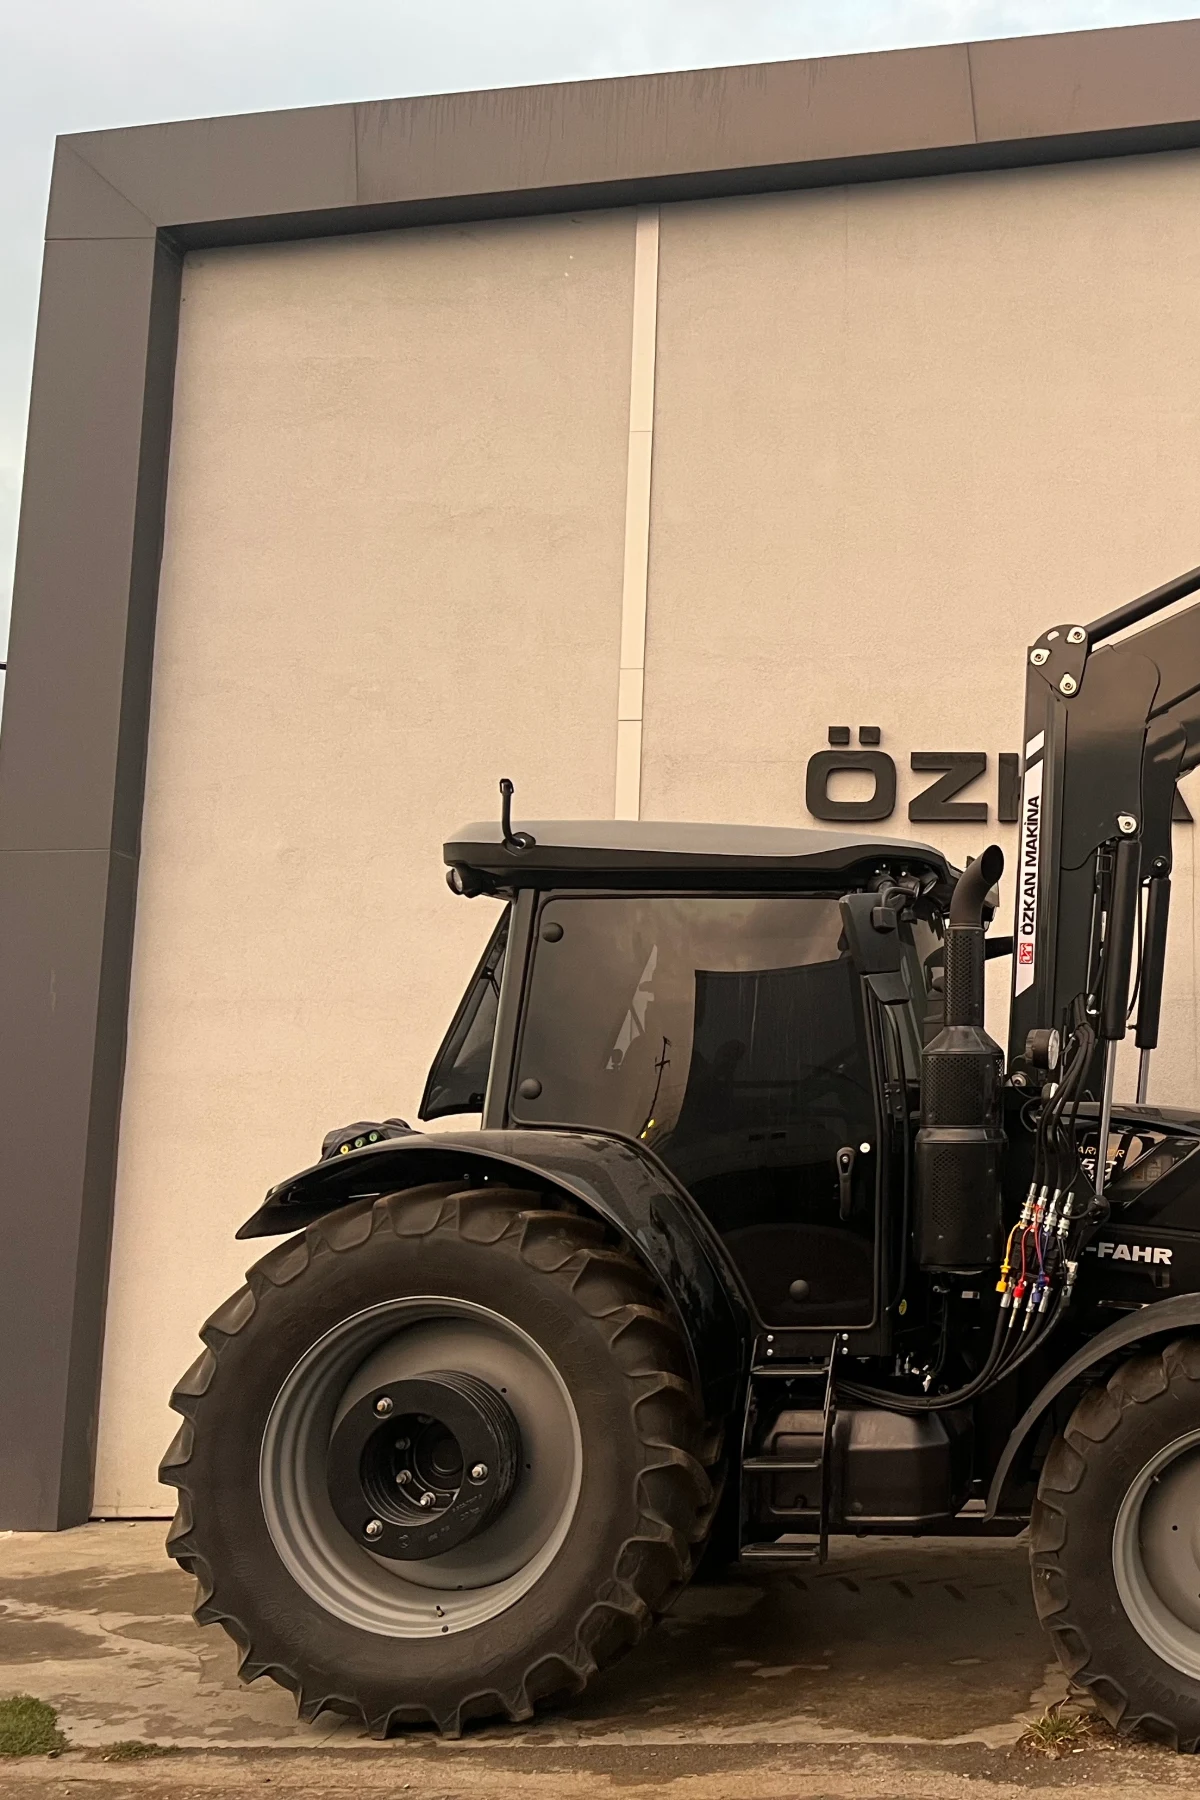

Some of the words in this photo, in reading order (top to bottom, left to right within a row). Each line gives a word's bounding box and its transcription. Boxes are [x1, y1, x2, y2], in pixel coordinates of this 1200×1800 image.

[1024, 795, 1039, 867] MAKİNA
[1020, 872, 1036, 935] ÖZKAN
[1081, 1242, 1173, 1265] -FAHR
